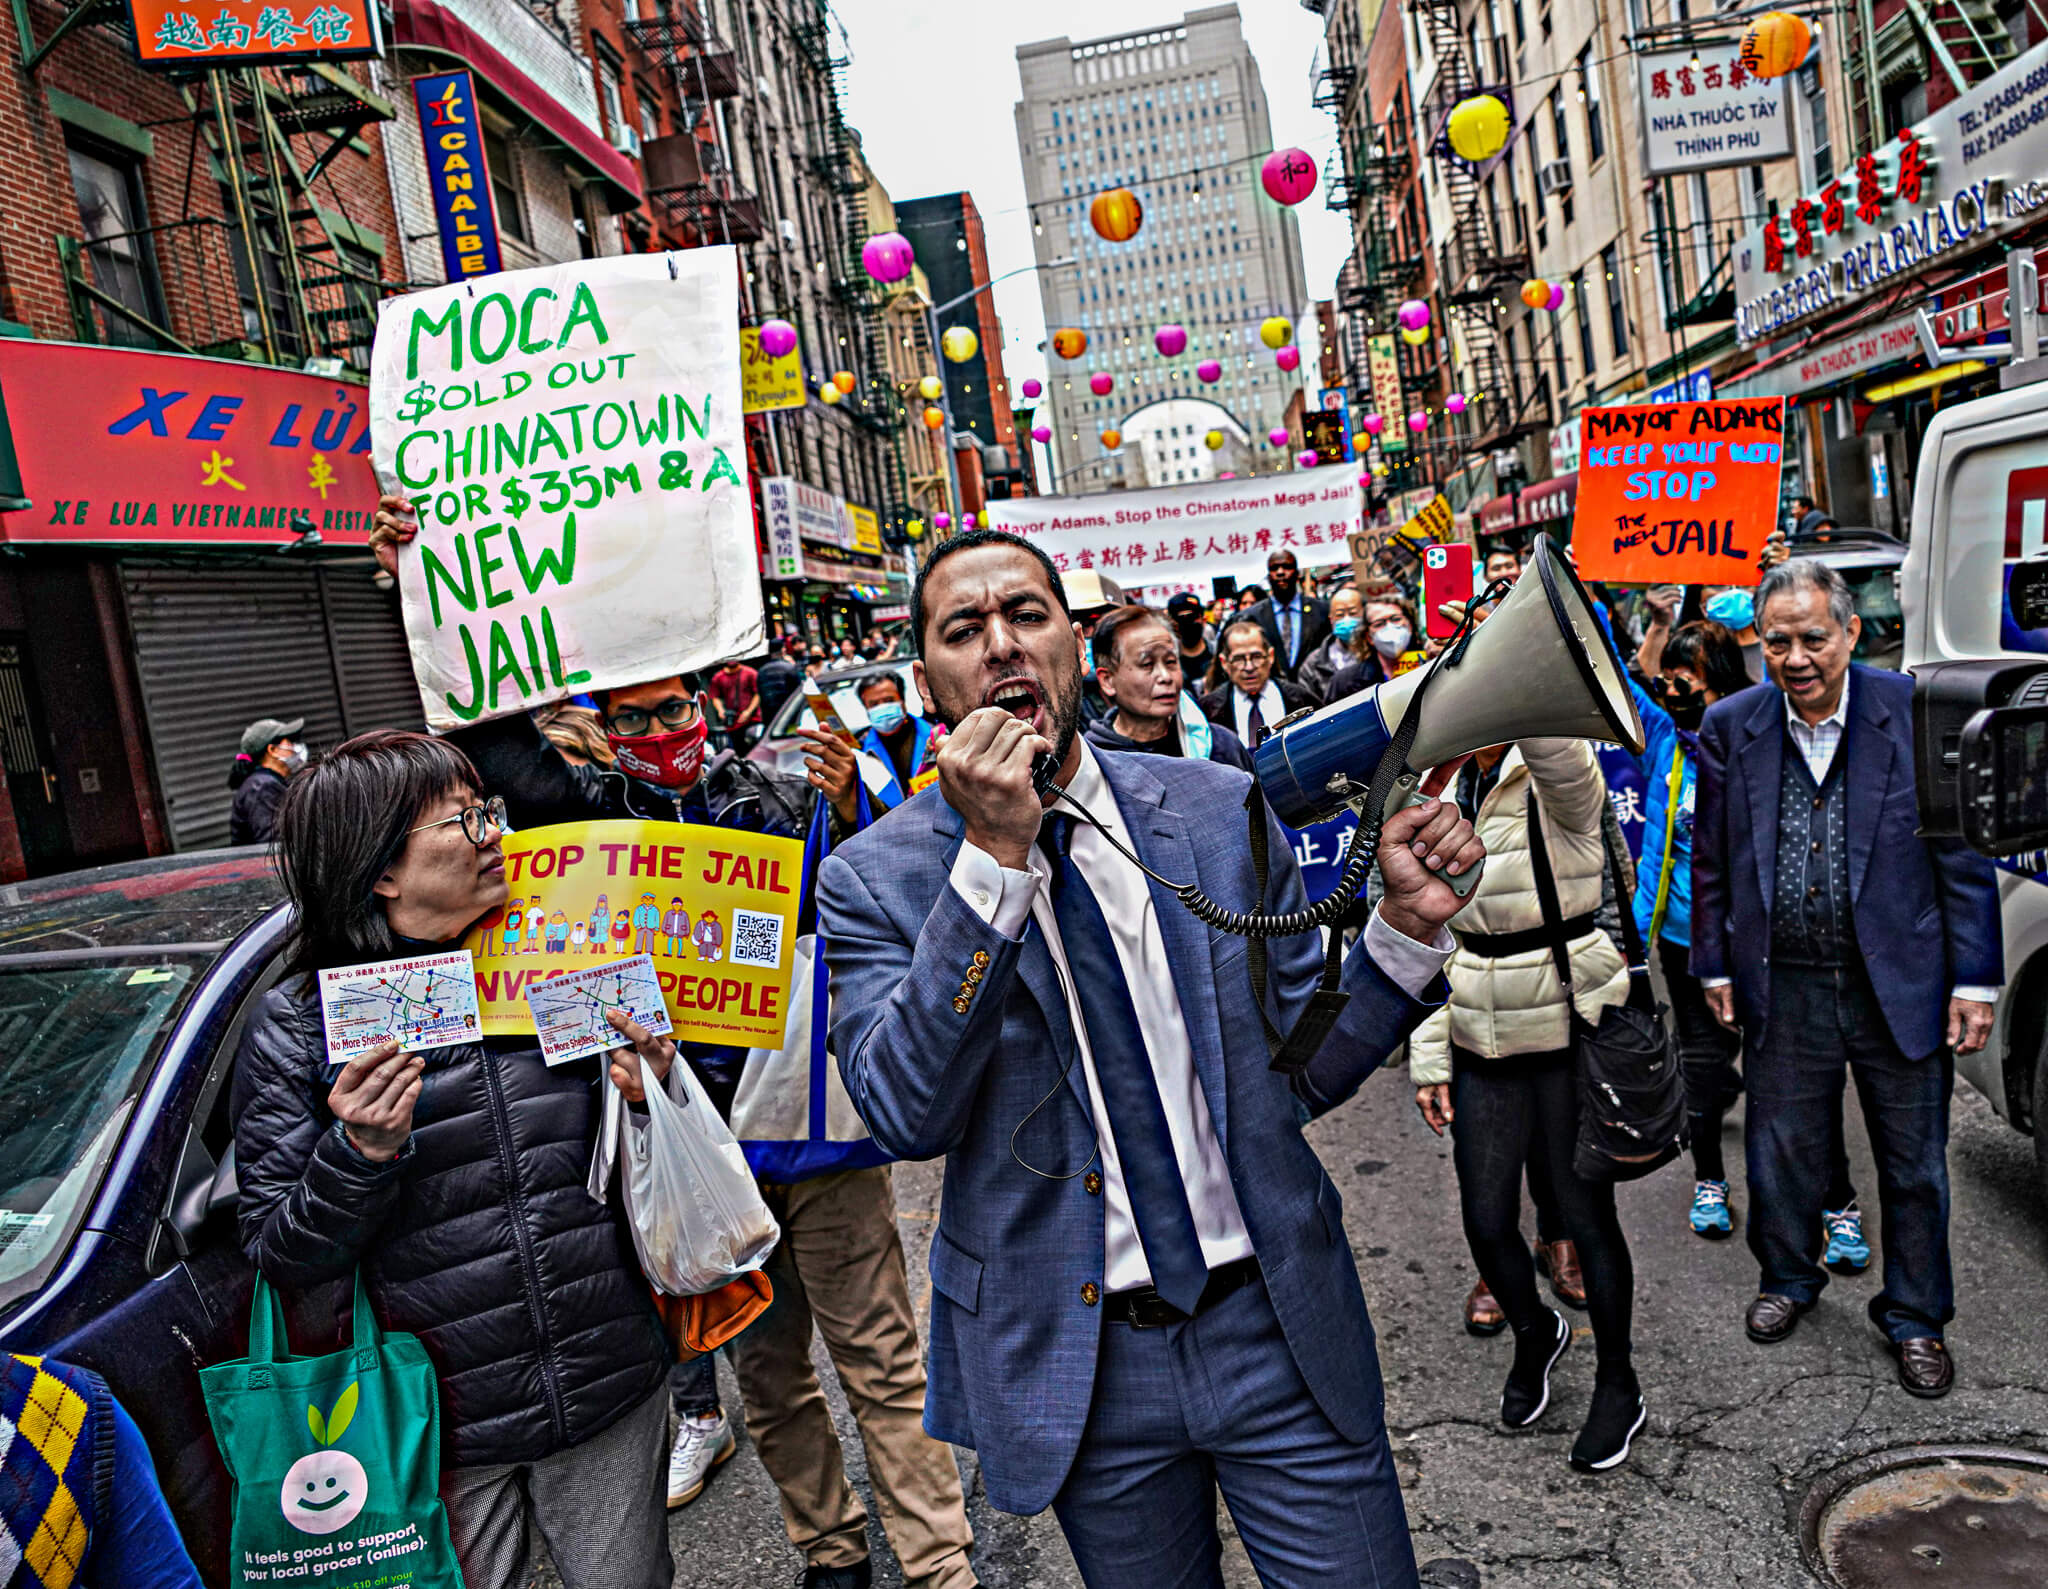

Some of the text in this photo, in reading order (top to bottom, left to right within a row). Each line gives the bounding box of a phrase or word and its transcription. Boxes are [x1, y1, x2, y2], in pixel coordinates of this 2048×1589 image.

[155, 6, 352, 51] 越南餐館
[1282, 156, 1308, 182] 和
[1842, 177, 1990, 292] PHARMACY
[406, 282, 609, 380] MOCA
[547, 353, 636, 389] OUT
[108, 388, 243, 441] XE
[1689, 404, 1782, 435] ADAMS
[395, 394, 712, 490] CHINATOWN
[1588, 443, 1654, 468] KEEP
[415, 446, 741, 531] FOR $35M & A
[1624, 470, 1717, 501] STOP
[50, 501, 89, 525] XE
[110, 502, 157, 527] LUA
[172, 504, 310, 530] VIETNAMESE
[997, 486, 1354, 537] Mayor Adams, Stop the Chinatown Mega Jail!
[1651, 519, 1748, 560] JAIL
[421, 513, 577, 630] NEW
[445, 605, 592, 721] JAIL
[503, 844, 791, 895] TOP THE JAIL
[659, 974, 780, 1018] PEOPLE
[331, 1034, 391, 1051] No More Shelters
[702, 1021, 720, 1029] Mayor
[721, 1023, 741, 1031] Adams
[544, 1046, 553, 1055] No
[554, 1041, 570, 1052] More
[243, 1535, 427, 1582] your local grocer (online).
[245, 1522, 416, 1564] It feels good to support
[375, 1576, 388, 1585] off
[392, 1571, 413, 1584] your
